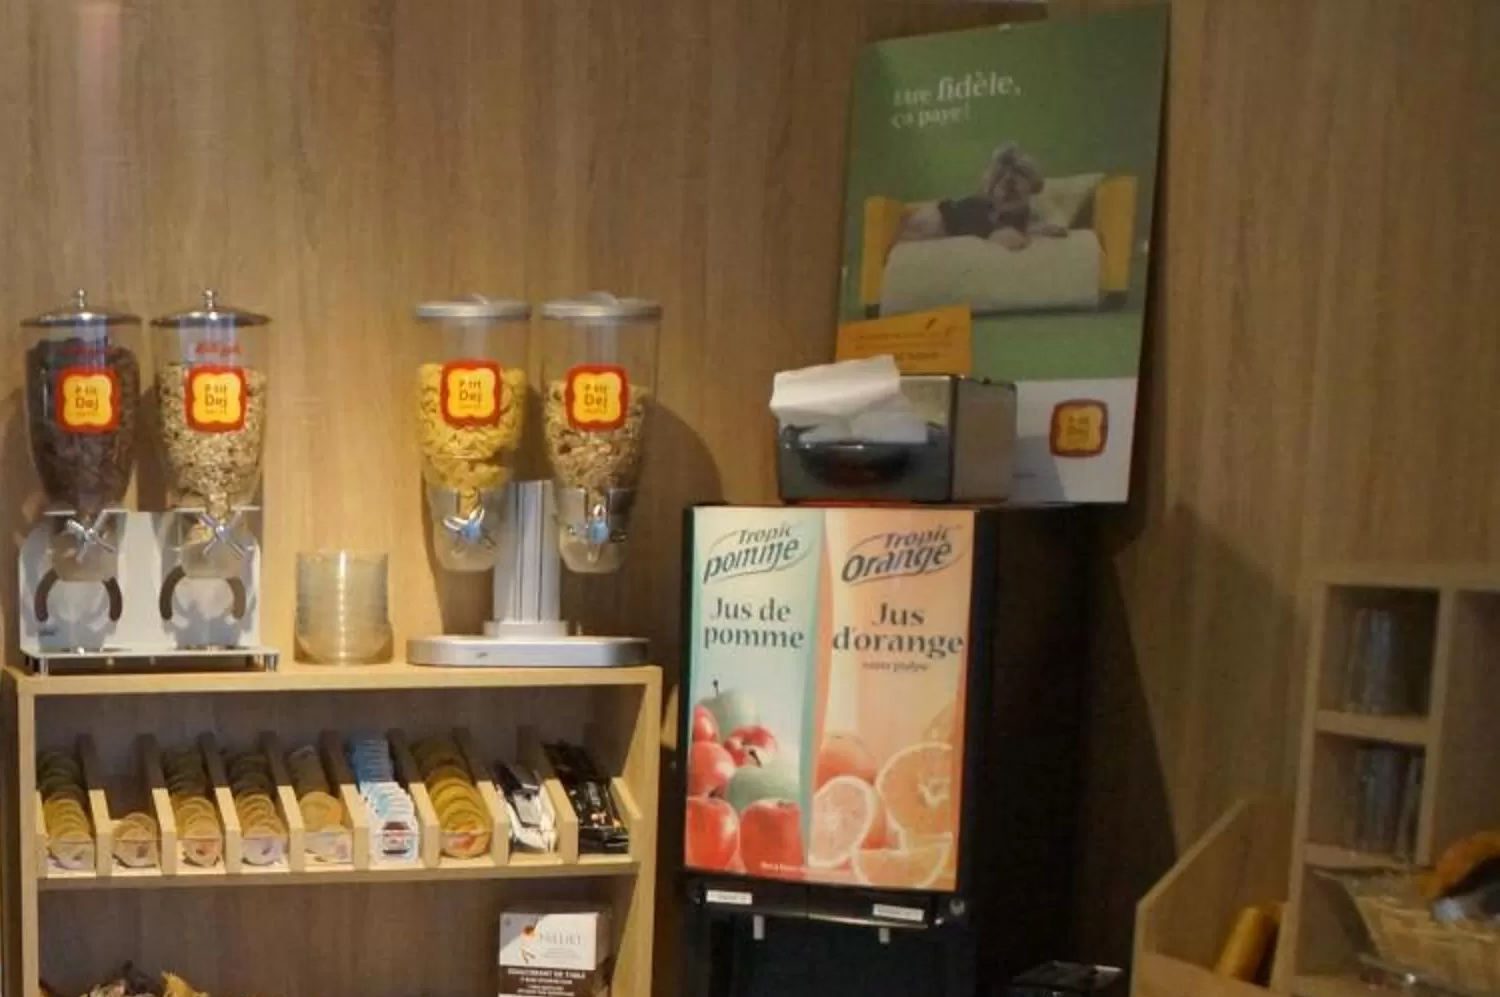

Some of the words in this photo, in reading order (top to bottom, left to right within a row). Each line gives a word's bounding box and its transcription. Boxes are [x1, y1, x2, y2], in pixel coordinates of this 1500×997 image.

[738, 524, 793, 545] Tropic
[884, 525, 951, 549] Tropic
[703, 535, 800, 584] pomme
[841, 541, 952, 583] Orange
[709, 597, 753, 622] Jus
[759, 597, 792, 623] de
[871, 602, 925, 626] Jus
[703, 625, 805, 650] pomme
[832, 625, 965, 659] d'orange
